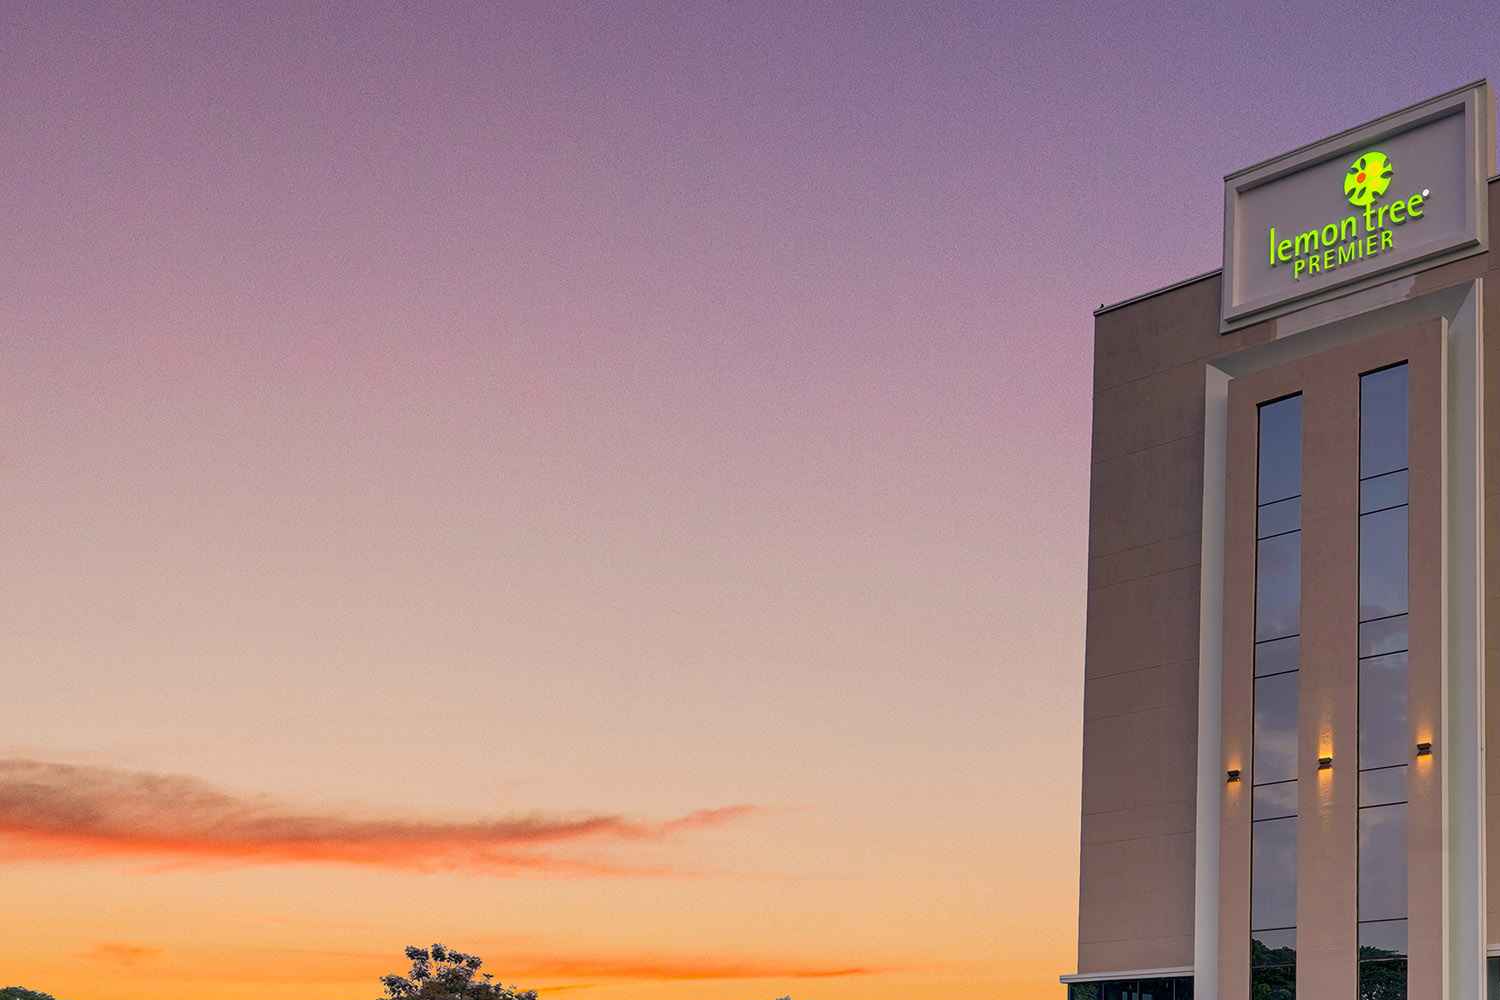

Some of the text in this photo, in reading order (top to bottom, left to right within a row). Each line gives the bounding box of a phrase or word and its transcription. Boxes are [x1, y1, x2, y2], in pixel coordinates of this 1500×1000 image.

[1270, 193, 1424, 265] lemon tree
[1294, 230, 1393, 279] PREMIER
